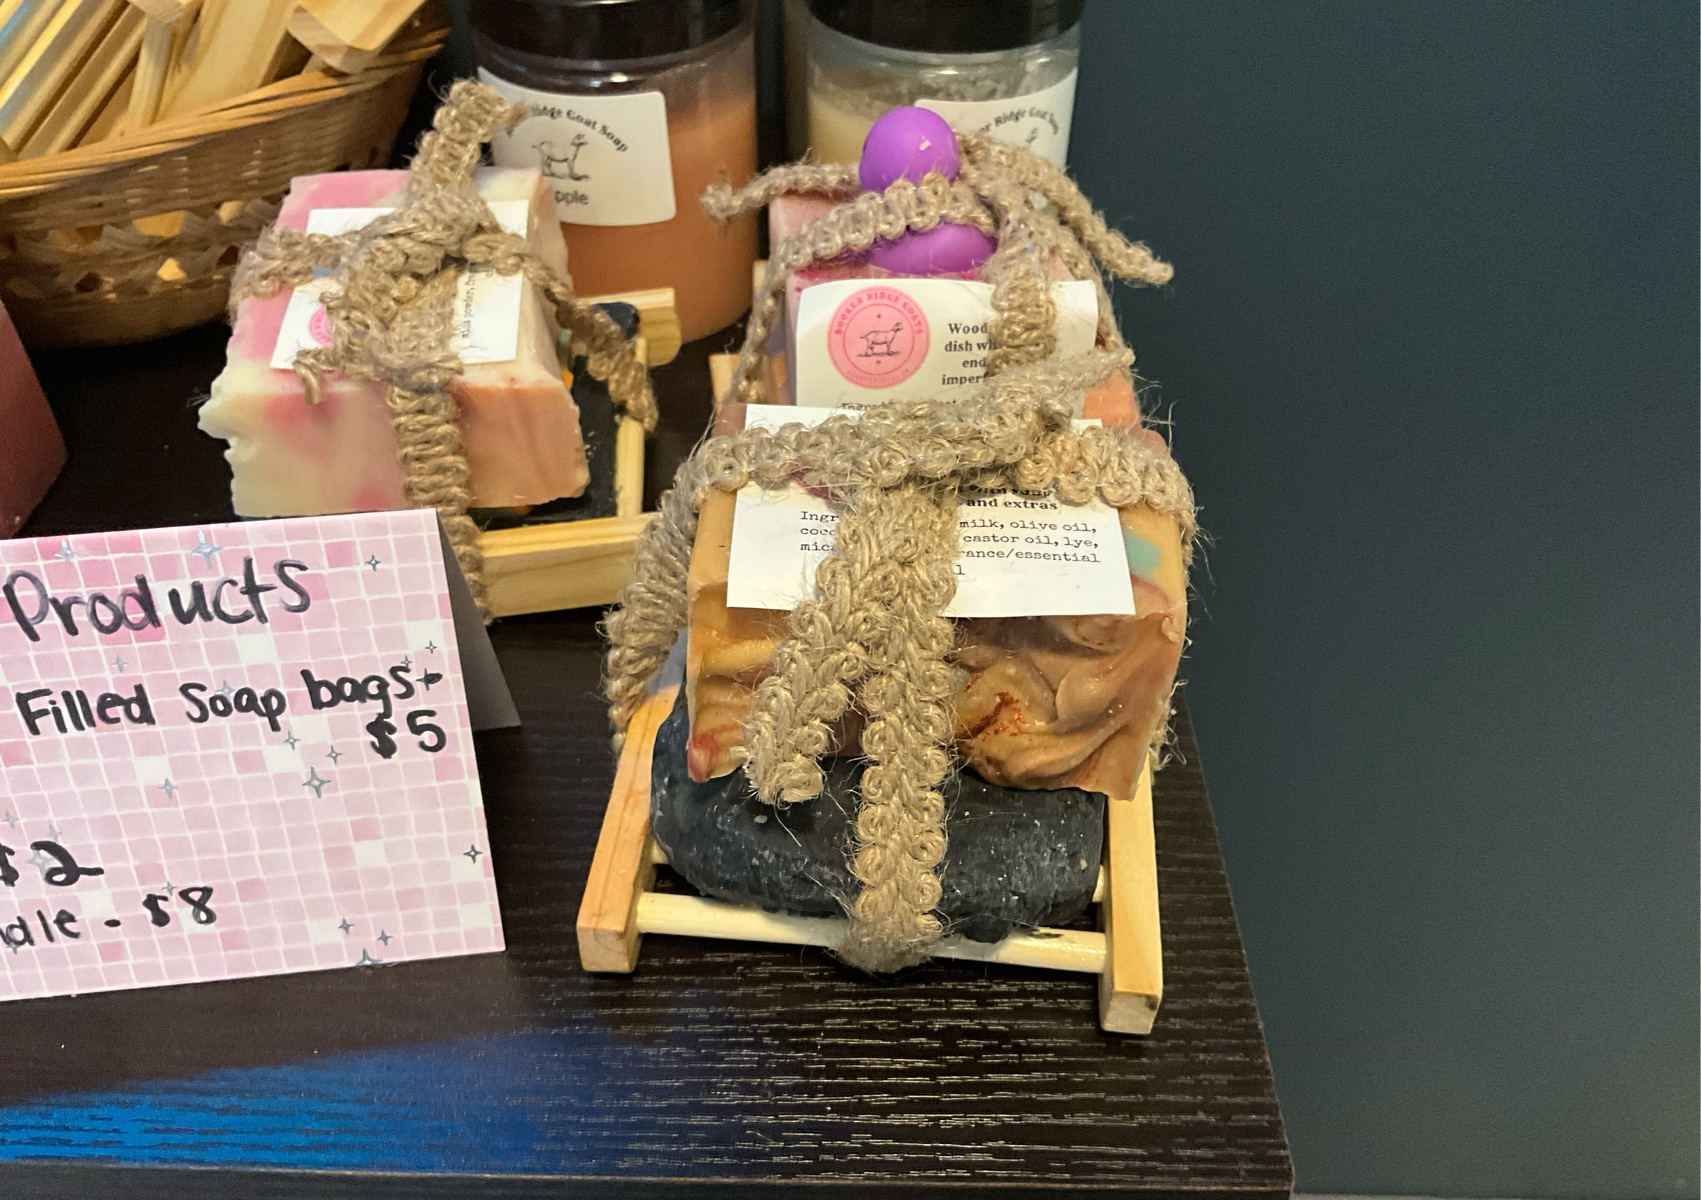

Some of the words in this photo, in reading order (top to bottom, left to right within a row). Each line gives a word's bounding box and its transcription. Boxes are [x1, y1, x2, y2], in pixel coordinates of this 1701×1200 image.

[598, 124, 629, 152] Soap
[554, 190, 589, 206] pple
[866, 291, 901, 304] RIDGE
[948, 322, 988, 335] Wood
[944, 340, 973, 353] dish
[966, 498, 999, 508] and
[1003, 500, 1059, 511] extras
[800, 510, 840, 524] Ingr
[959, 518, 1005, 531] milk,
[1009, 520, 1058, 532] olive
[1062, 522, 1097, 535] oil,
[963, 533, 1020, 544] castor
[1024, 534, 1060, 548] oil,
[1064, 536, 1100, 550] lye,
[963, 548, 1101, 564] ance/essential
[3, 556, 312, 642] Products
[16, 683, 156, 735] Filled
[179, 682, 287, 732] Soap
[365, 709, 447, 759] $5
[141, 886, 218, 928] $8
